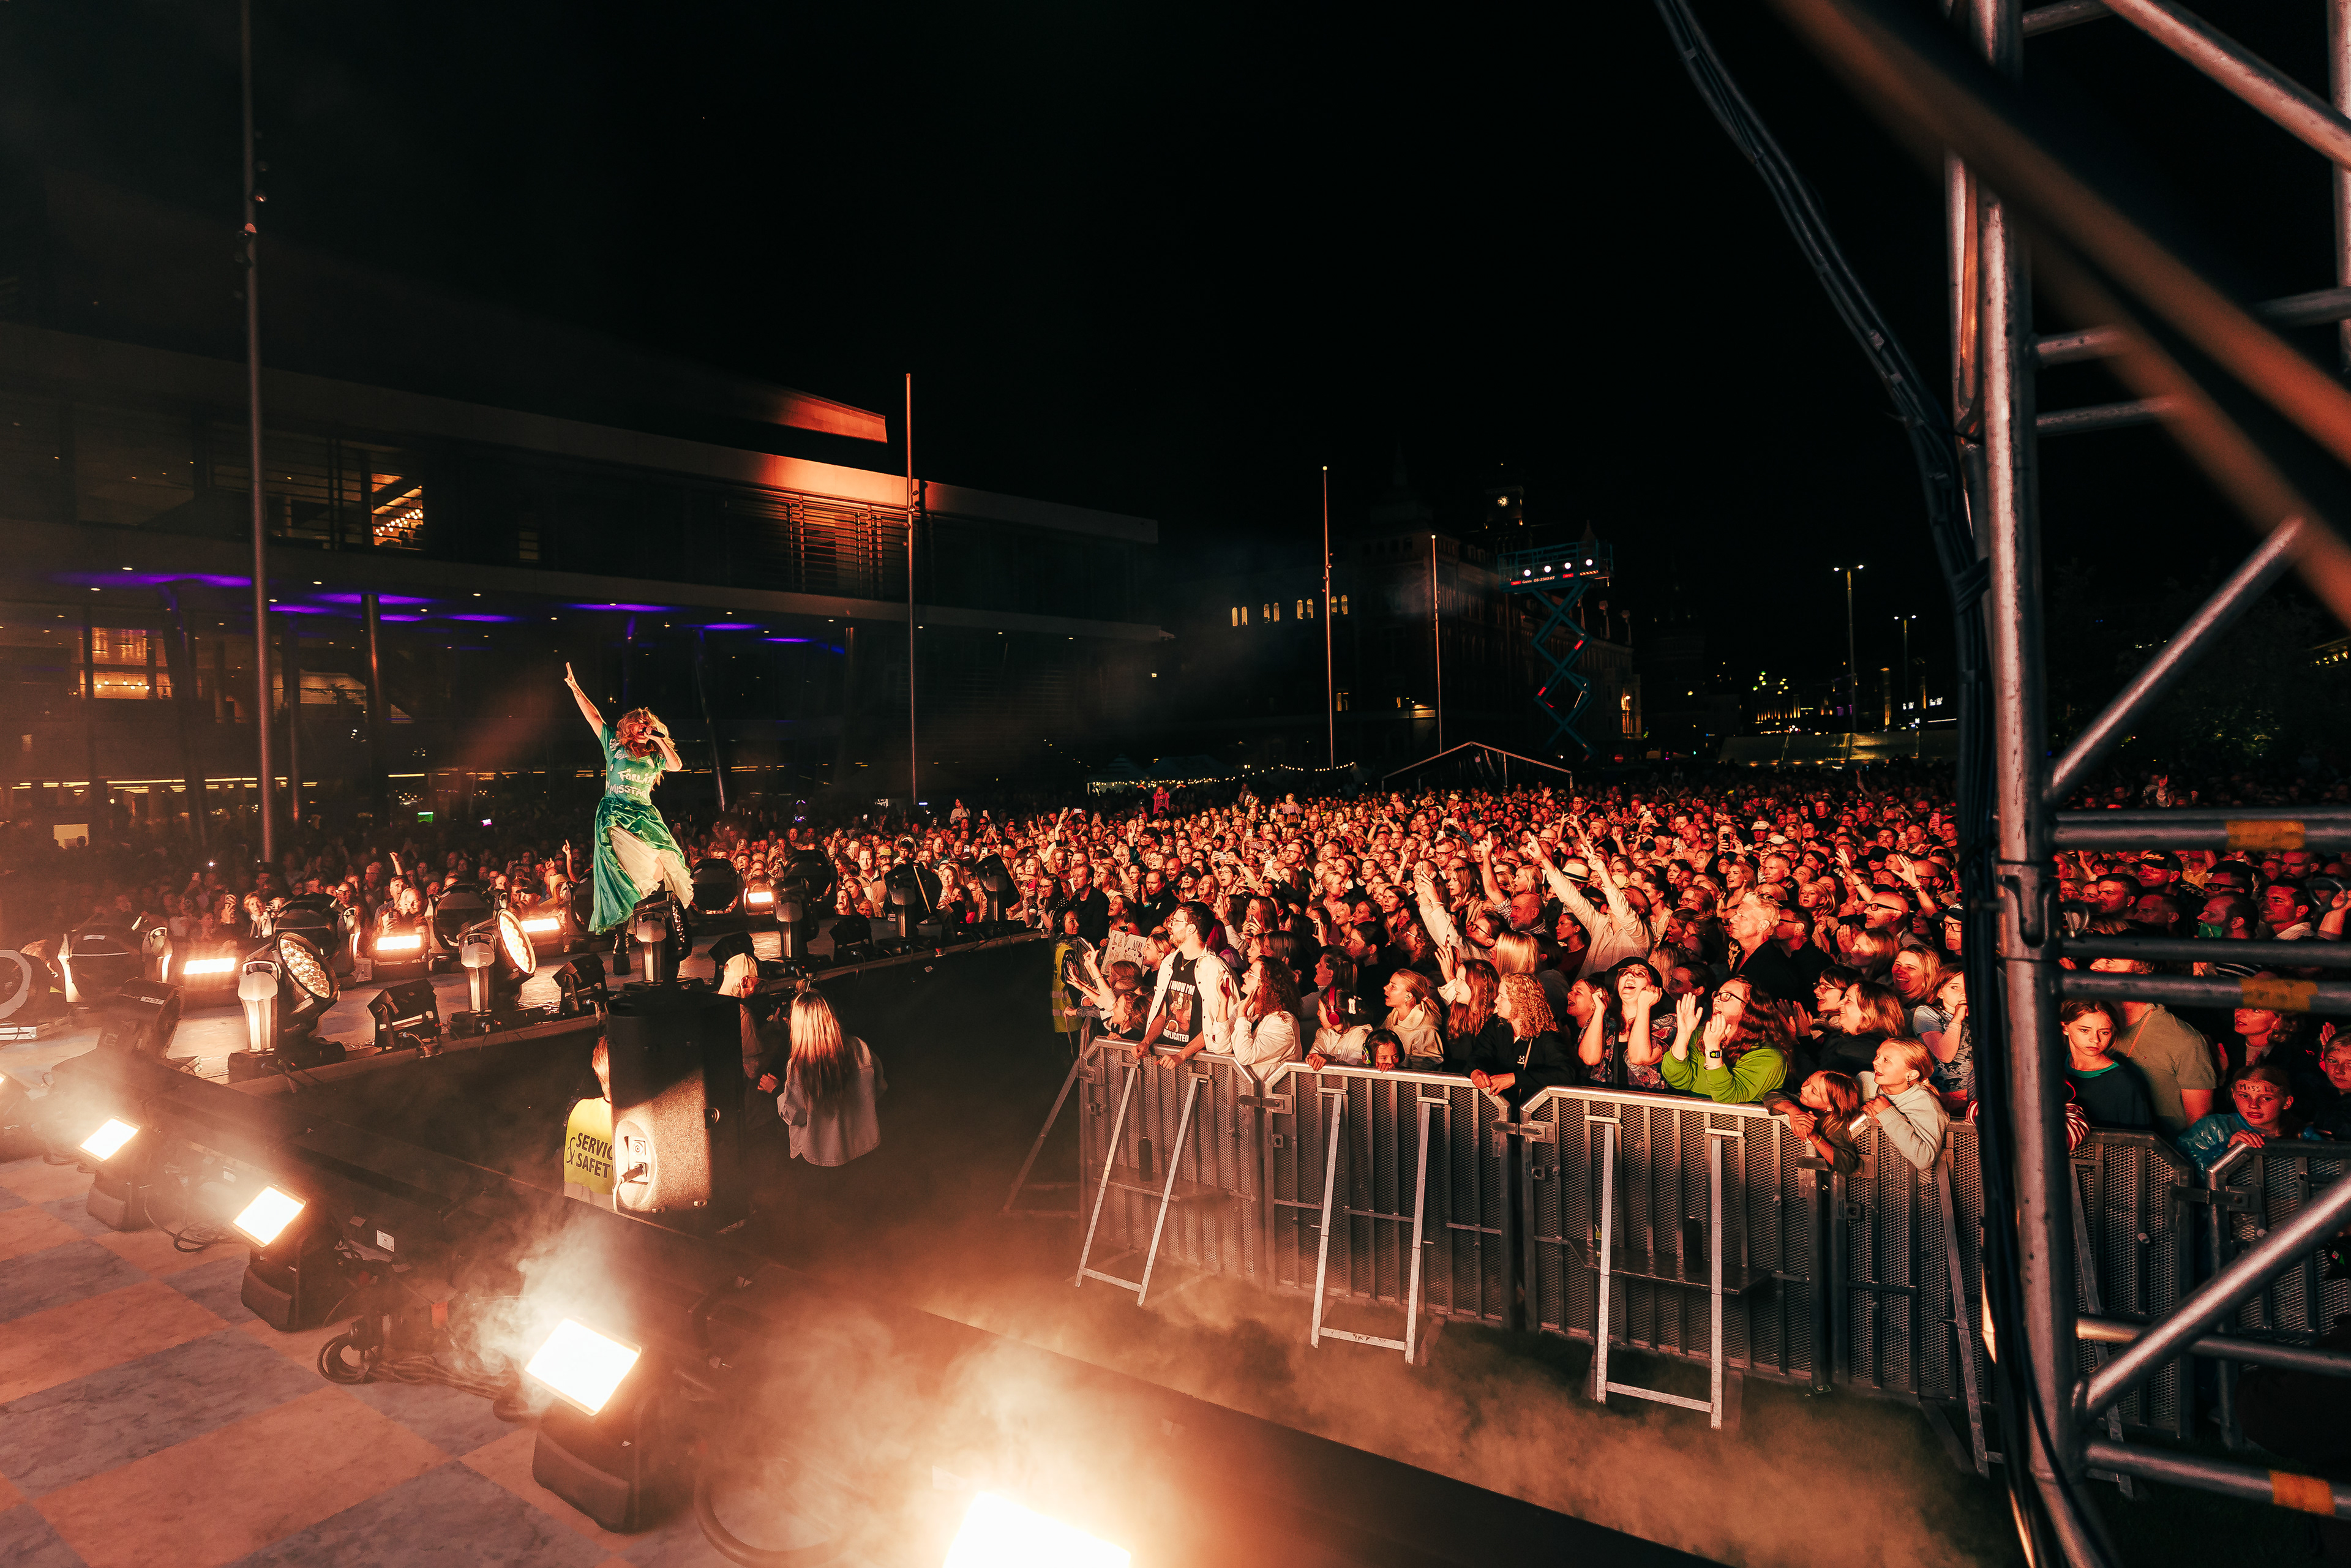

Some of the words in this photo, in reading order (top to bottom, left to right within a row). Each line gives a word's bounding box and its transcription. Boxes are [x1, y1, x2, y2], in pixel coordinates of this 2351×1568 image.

[1112, 933, 1130, 948] LEV
[566, 1136, 576, 1165] &
[576, 1152, 613, 1179] SAFET
[576, 1132, 613, 1160] SERVIC
